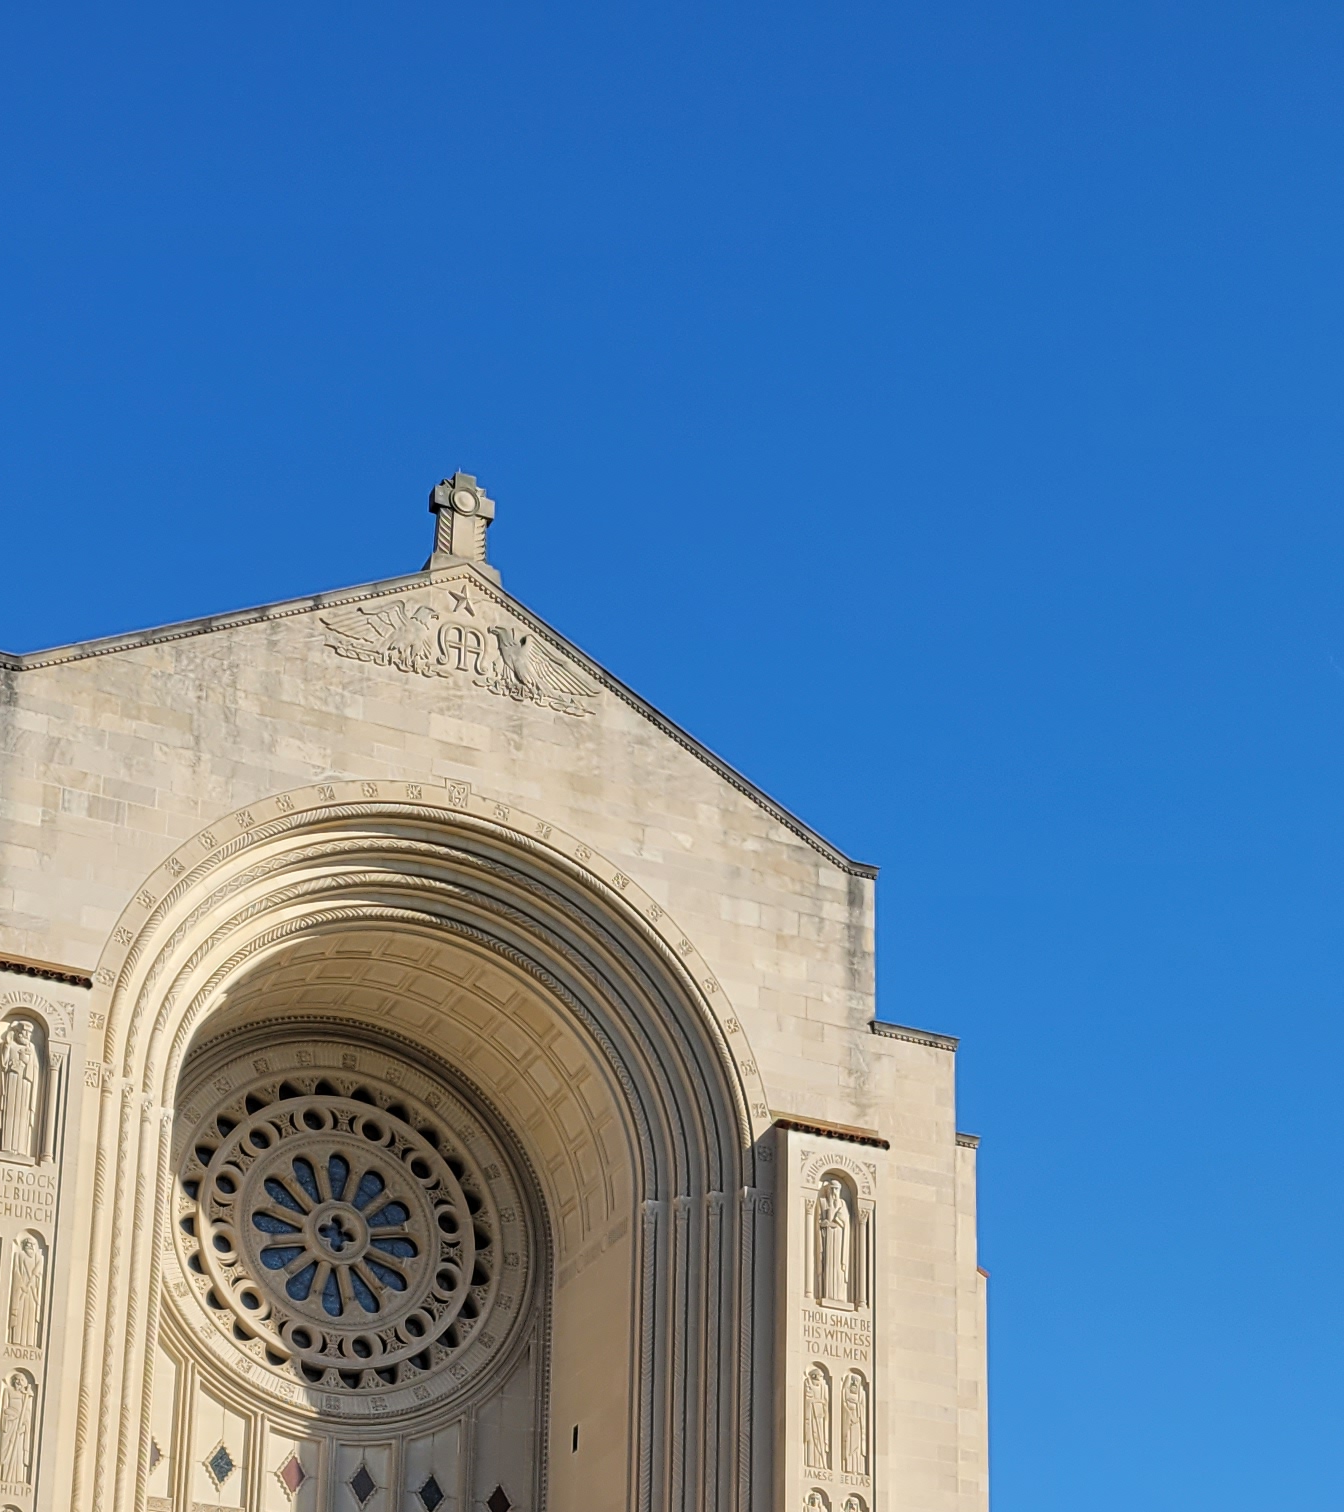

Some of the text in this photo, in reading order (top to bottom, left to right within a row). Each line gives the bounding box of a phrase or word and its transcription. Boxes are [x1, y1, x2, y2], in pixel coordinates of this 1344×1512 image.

[17, 1170, 55, 1190] ROCK
[13, 1187, 54, 1206] BUILD
[801, 1309, 871, 1332] THOU SHALT BE
[803, 1325, 871, 1348] HIS WITNESS
[806, 1340, 868, 1361] TO ALL MEN
